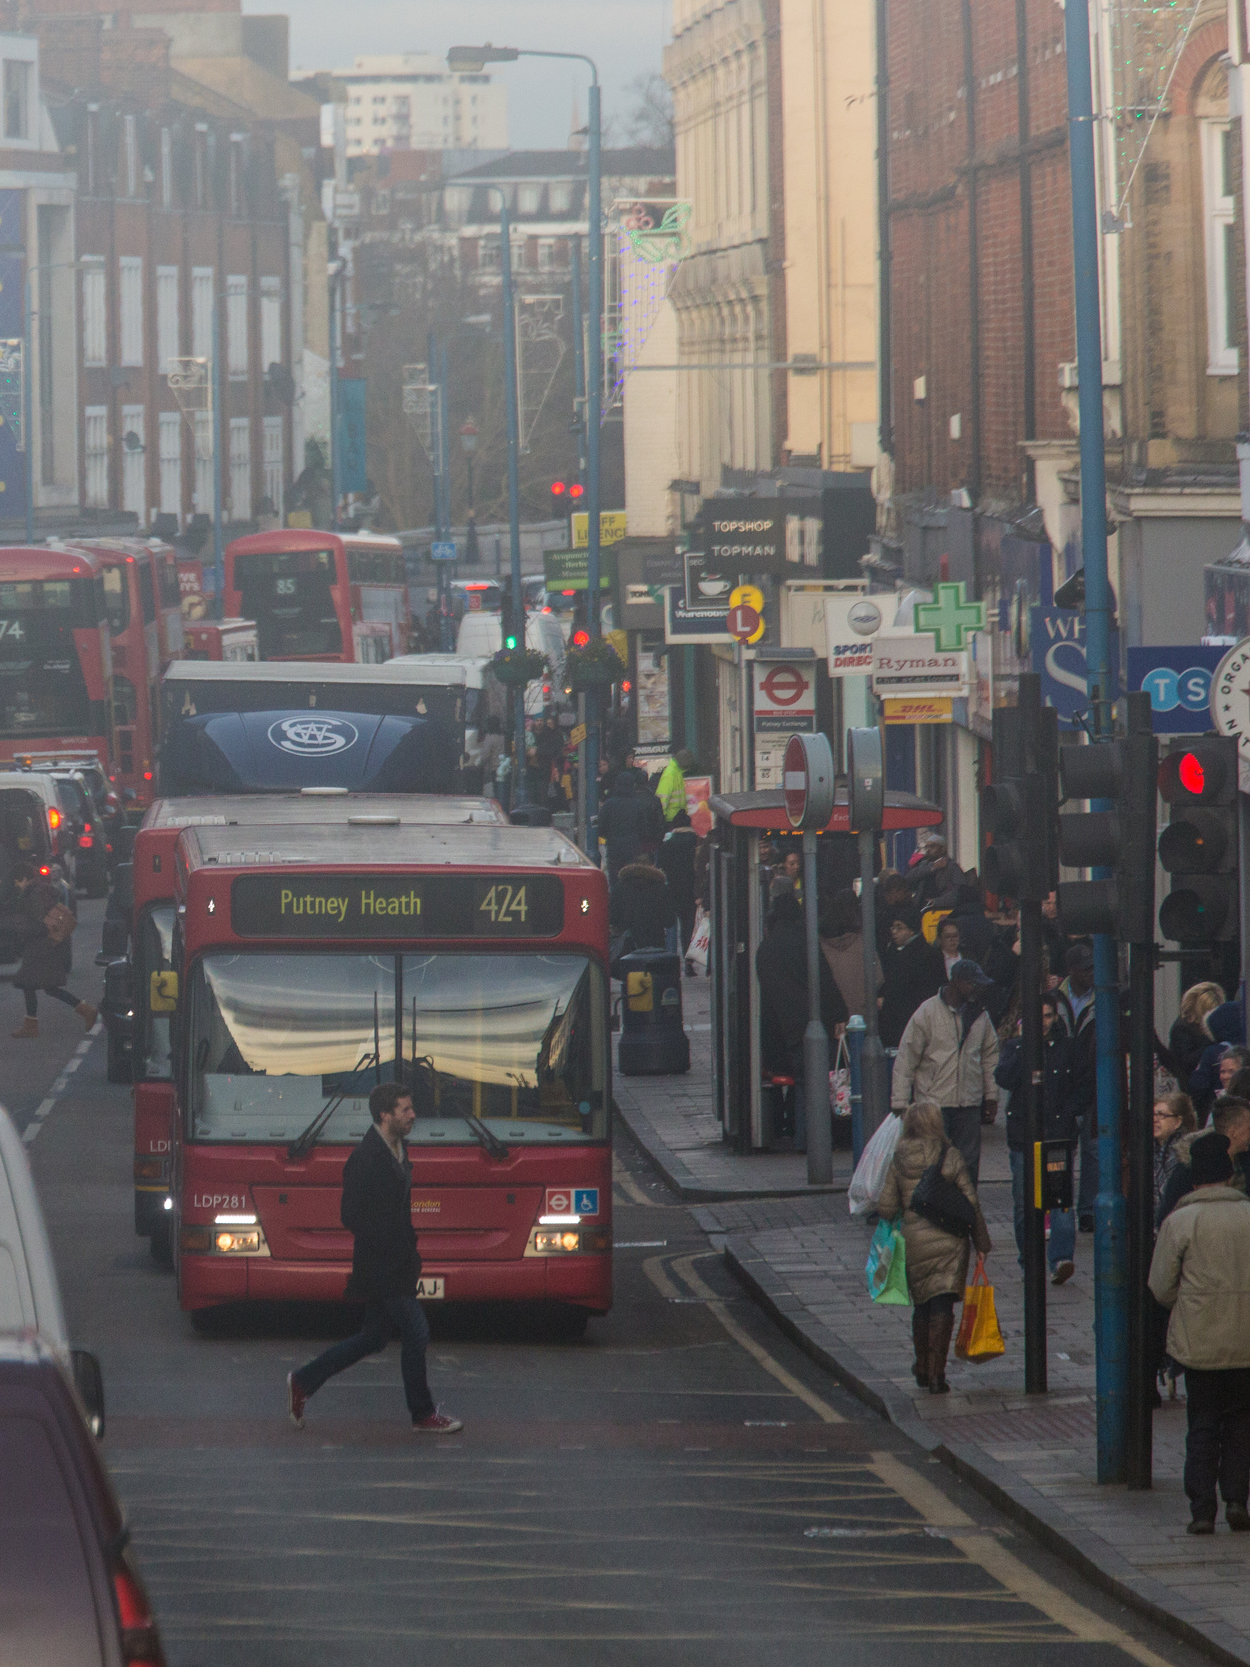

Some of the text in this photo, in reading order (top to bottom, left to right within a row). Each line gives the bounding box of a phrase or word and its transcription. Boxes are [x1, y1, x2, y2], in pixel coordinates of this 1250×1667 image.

[600, 516, 616, 528] FF
[712, 519, 774, 533] TOPSHOP
[712, 545, 776, 557] TOPMAN
[276, 579, 297, 594] 85
[736, 609, 751, 632] L
[876, 655, 959, 671] Ryman
[900, 704, 936, 713] DHL
[280, 885, 529, 923] Putney Heath 424
[193, 1193, 247, 1209] LDP281
